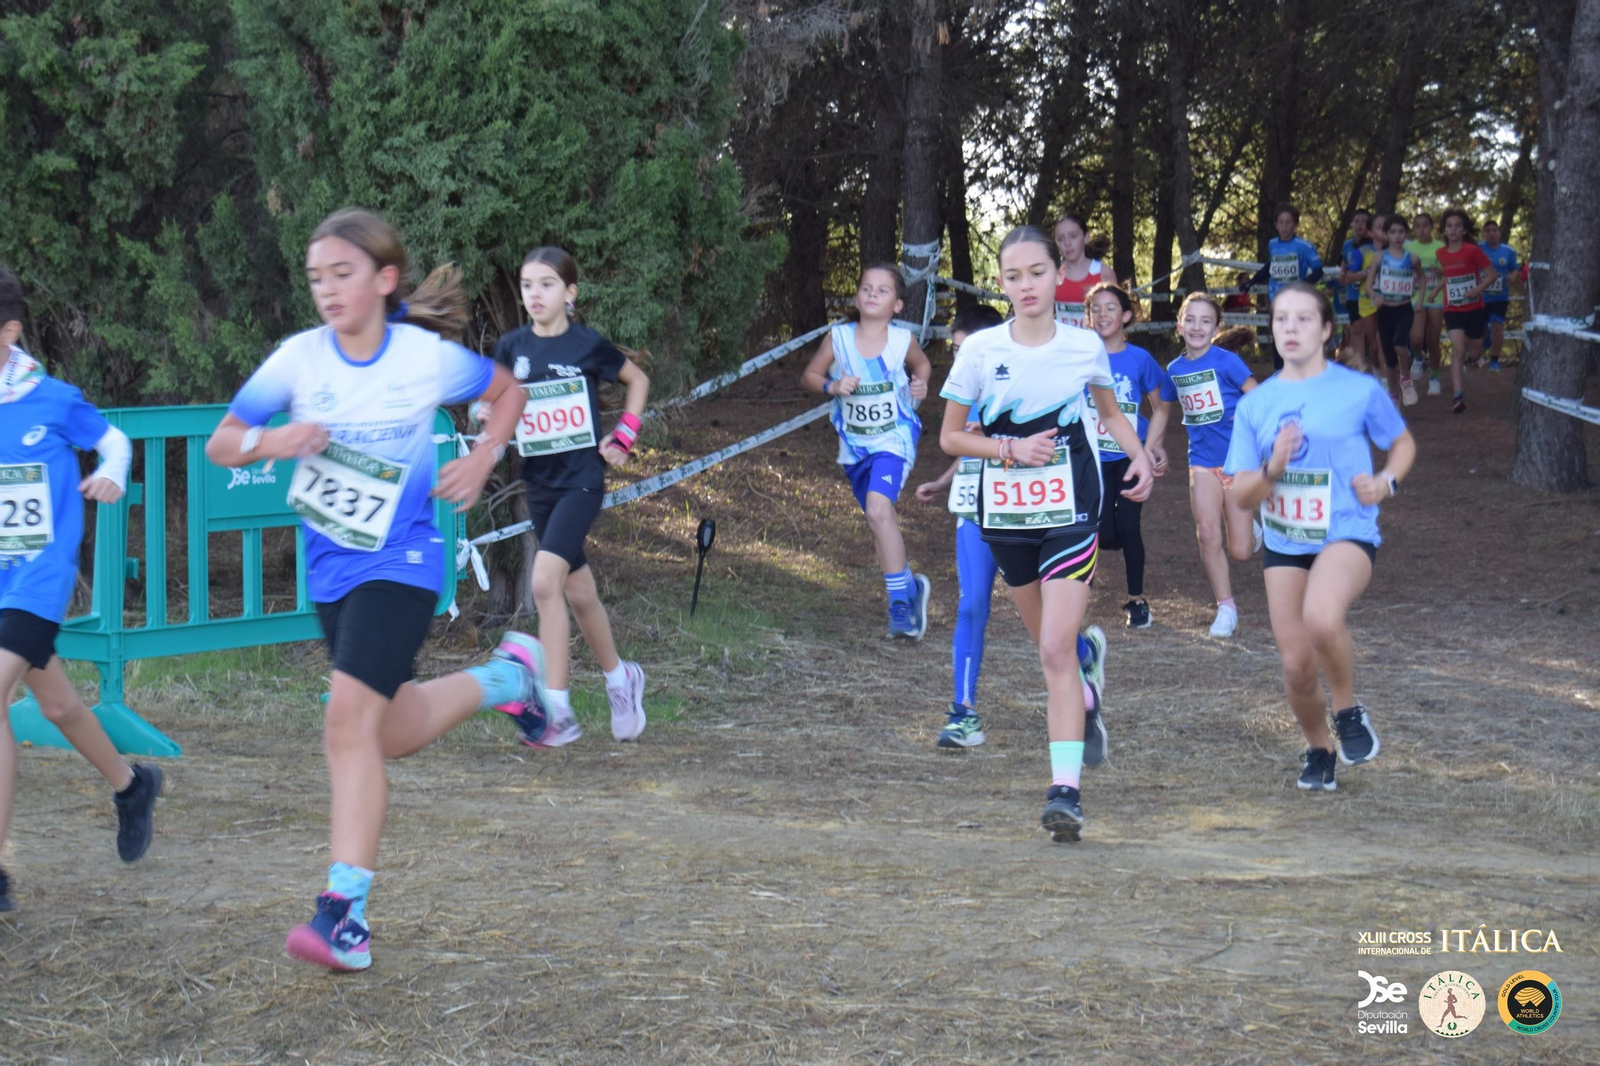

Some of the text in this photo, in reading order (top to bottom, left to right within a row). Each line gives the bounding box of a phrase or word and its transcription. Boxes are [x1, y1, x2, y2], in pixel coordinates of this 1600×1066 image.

[521, 405, 585, 435] 5090
[846, 402, 893, 421] 7863
[252, 474, 276, 485] Sevilla
[303, 465, 387, 523] 7837
[993, 478, 1067, 507] 5193
